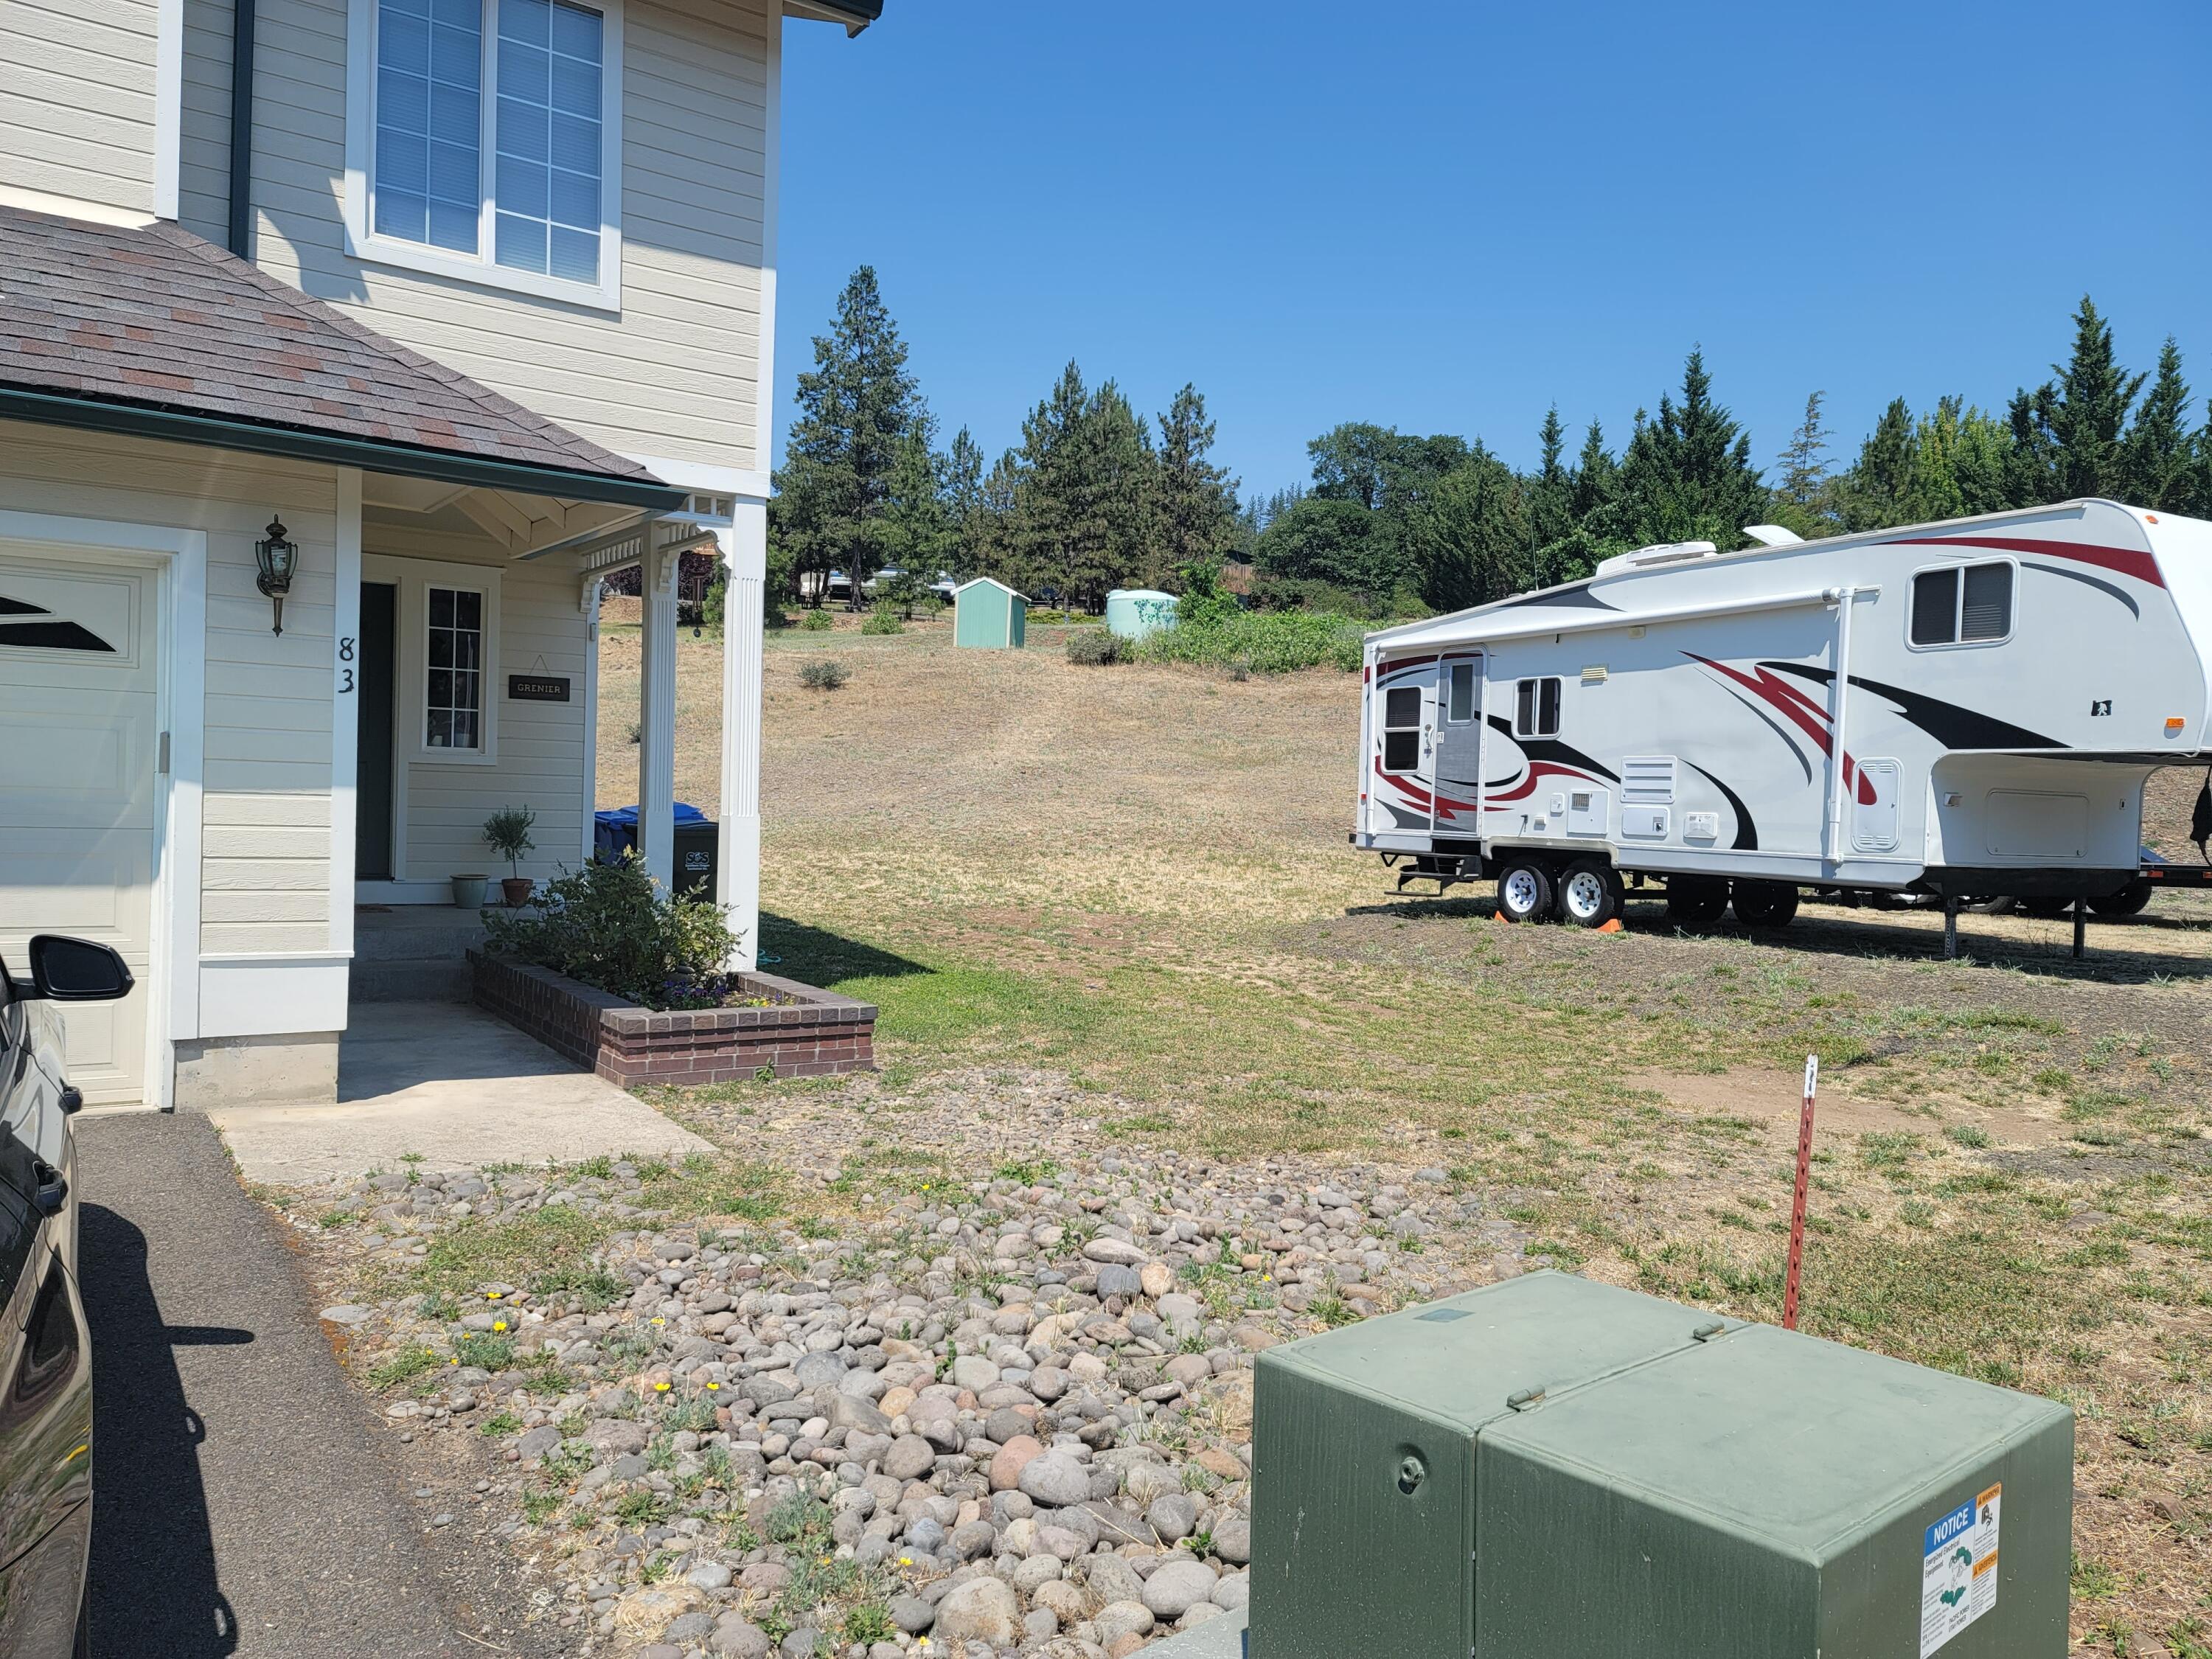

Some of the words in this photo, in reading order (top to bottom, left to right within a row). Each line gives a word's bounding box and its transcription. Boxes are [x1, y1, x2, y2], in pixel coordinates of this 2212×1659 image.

[338, 637, 355, 693] 83
[518, 684, 561, 693] GRENIER
[1934, 1507, 1969, 1545] NOTICE
[1925, 1548, 1944, 1567] Energized
[1943, 1537, 1961, 1554] Electrical
[1924, 1559, 1944, 1578] Equipment
